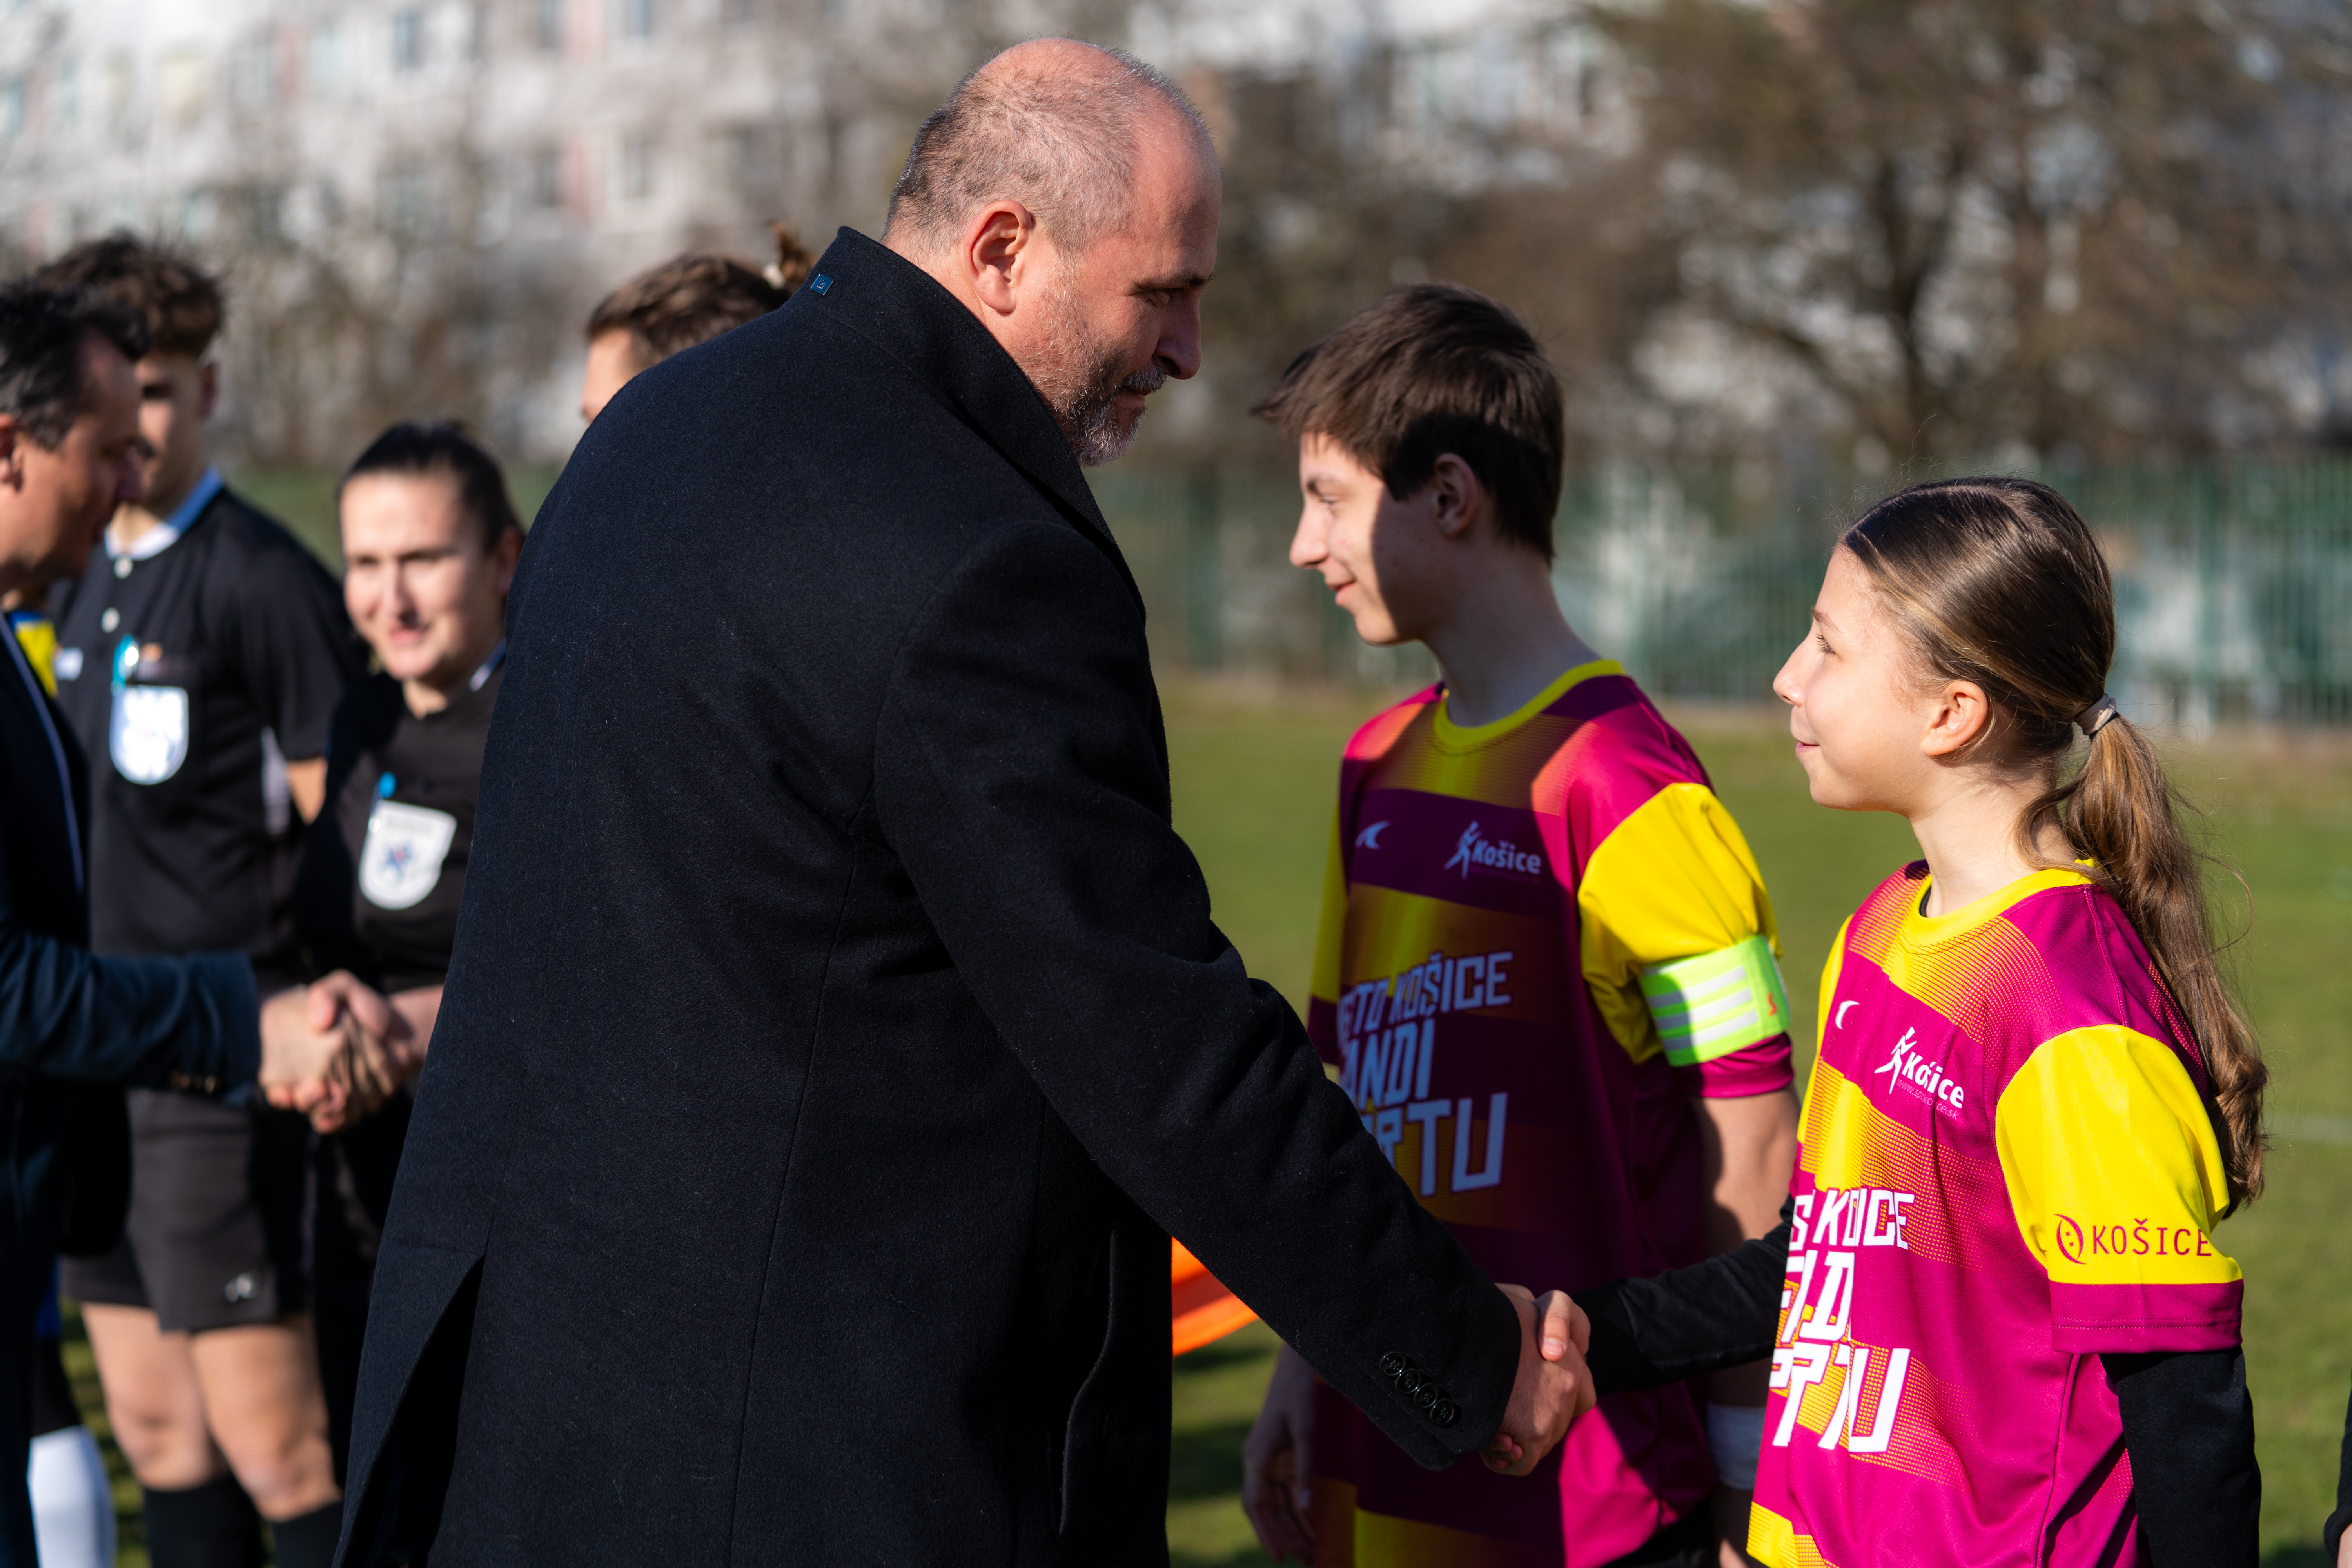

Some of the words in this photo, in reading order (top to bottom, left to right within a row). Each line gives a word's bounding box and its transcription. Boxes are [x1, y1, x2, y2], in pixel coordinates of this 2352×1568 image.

[1471, 838, 1541, 875] Košice
[1388, 950, 1513, 1024] KOŠICE
[2092, 1218, 2212, 1256] KOŠICE
